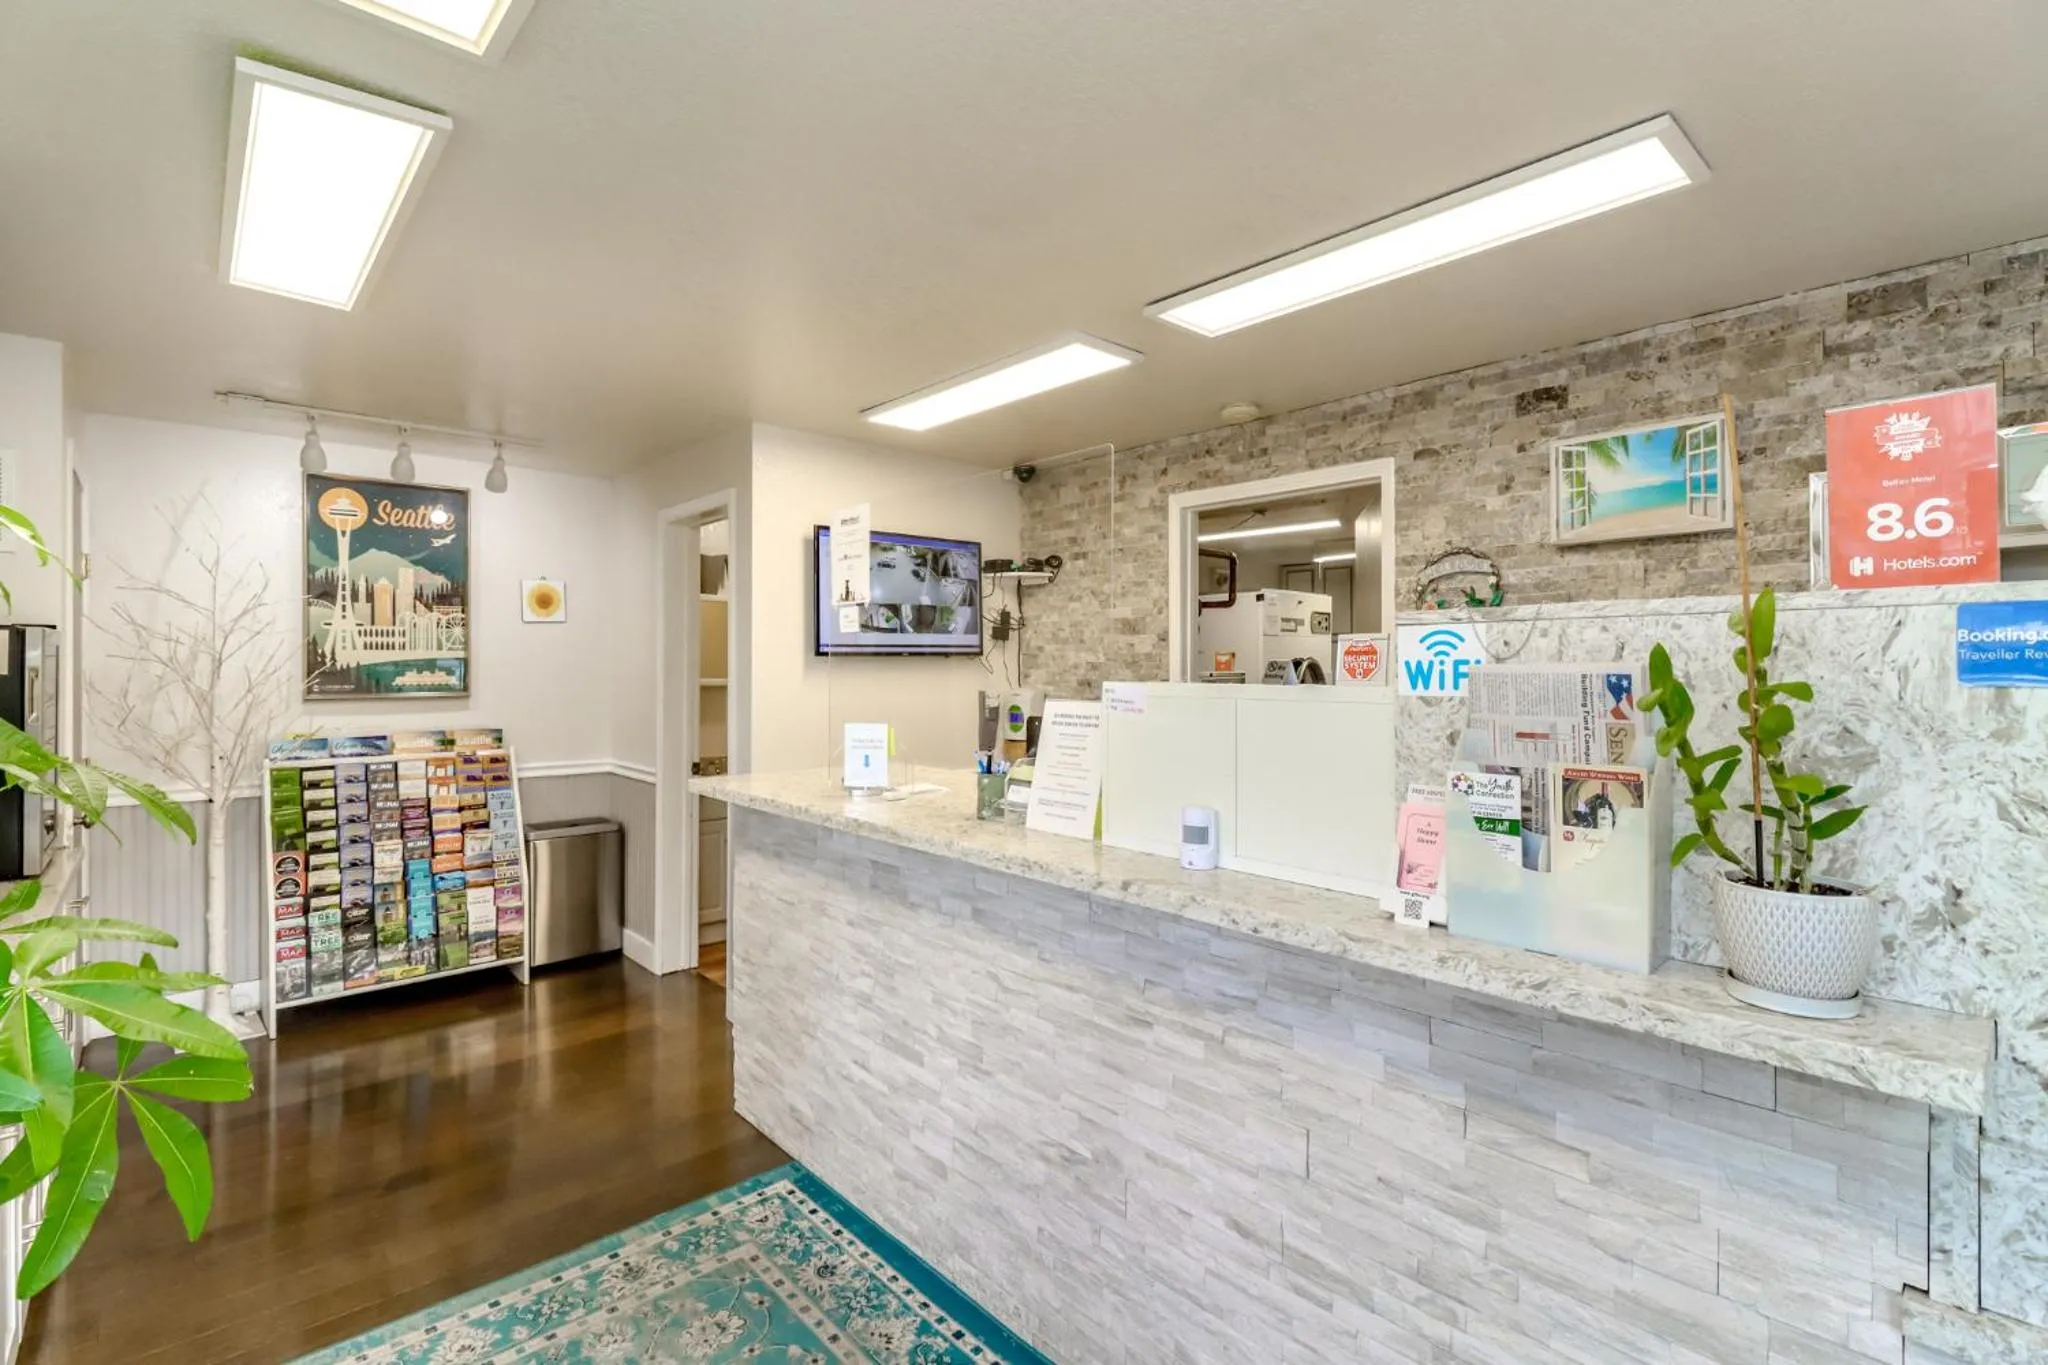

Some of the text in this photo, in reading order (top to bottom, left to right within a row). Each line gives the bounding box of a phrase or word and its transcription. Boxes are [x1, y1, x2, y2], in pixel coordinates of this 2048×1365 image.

[1867, 497, 1955, 542] 8.6
[1883, 555, 1977, 571] Hotels.com
[1959, 648, 2020, 661] Traveller
[1404, 659, 1481, 690] WiF
